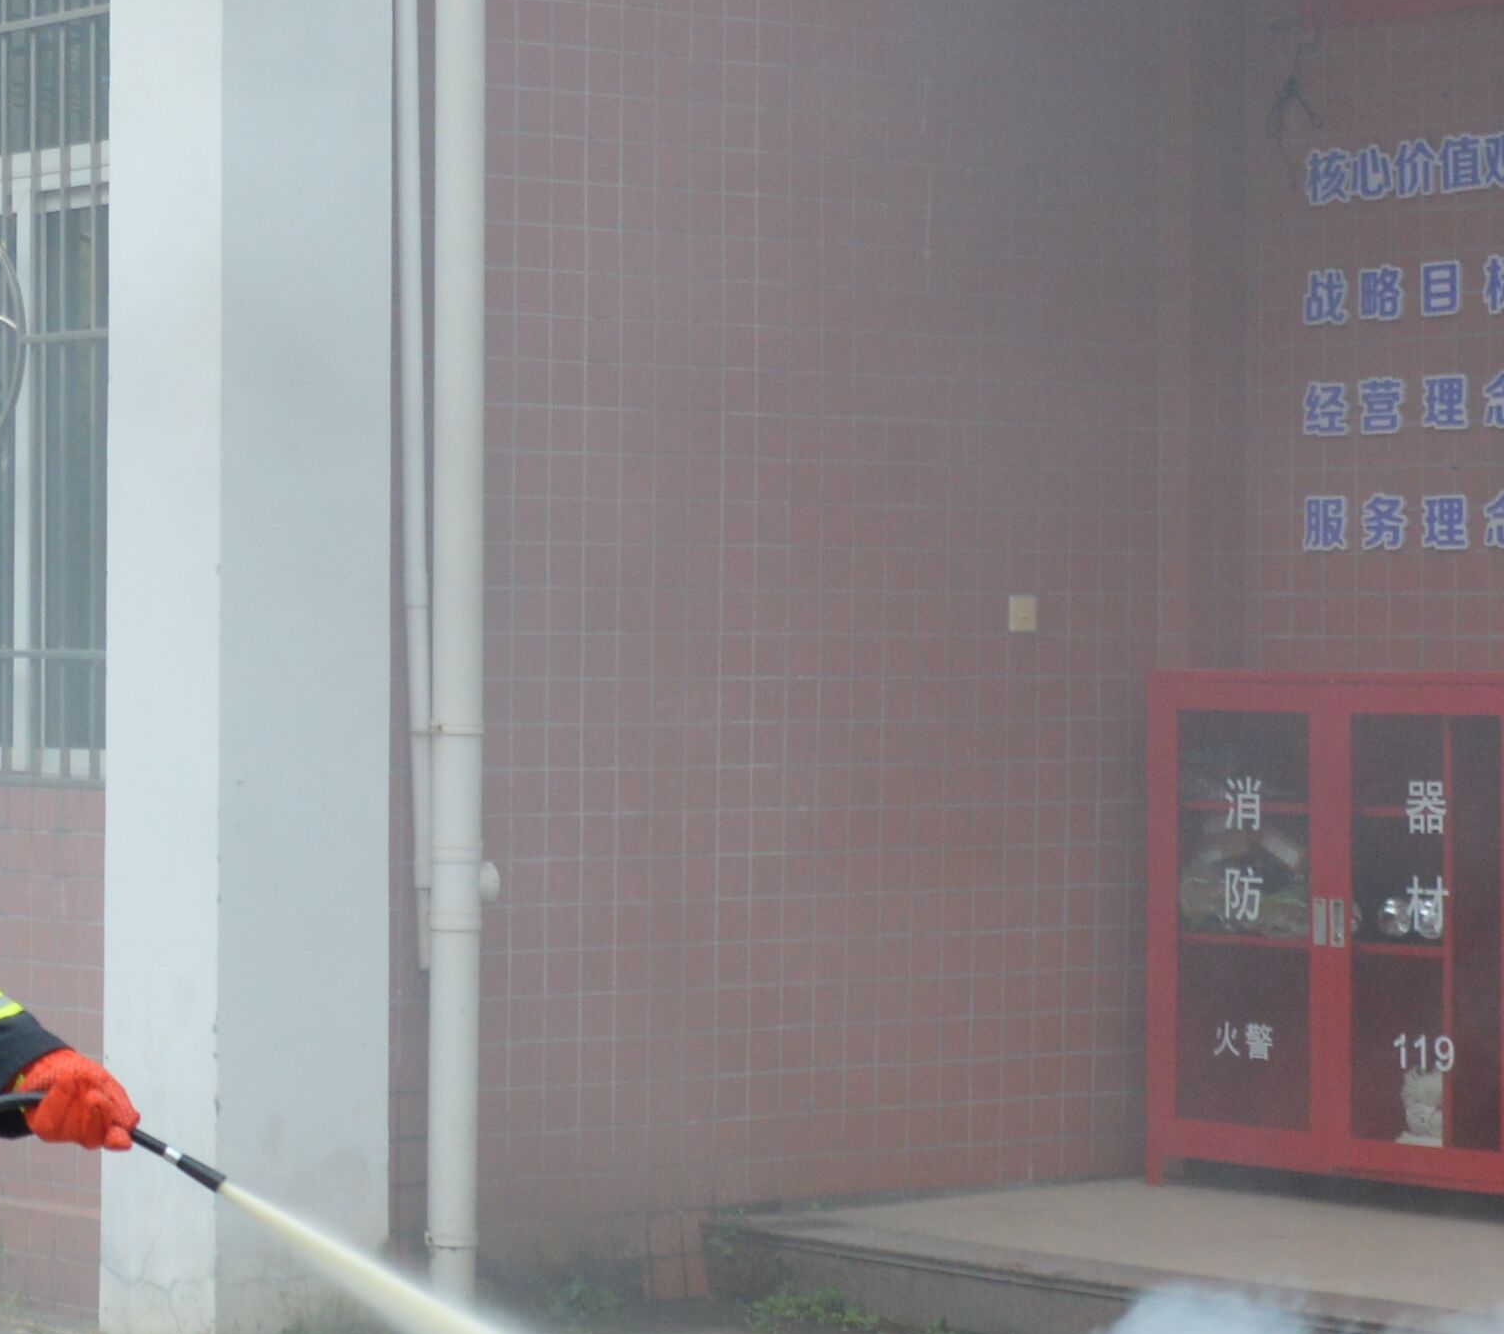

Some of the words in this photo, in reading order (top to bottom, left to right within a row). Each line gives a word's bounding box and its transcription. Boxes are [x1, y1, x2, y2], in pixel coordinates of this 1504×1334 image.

[1223, 776, 1264, 922] 消防
[1406, 780, 1449, 935] 器材
[1213, 1020, 1275, 1061] 火警
[1393, 1034, 1455, 1072] 119
